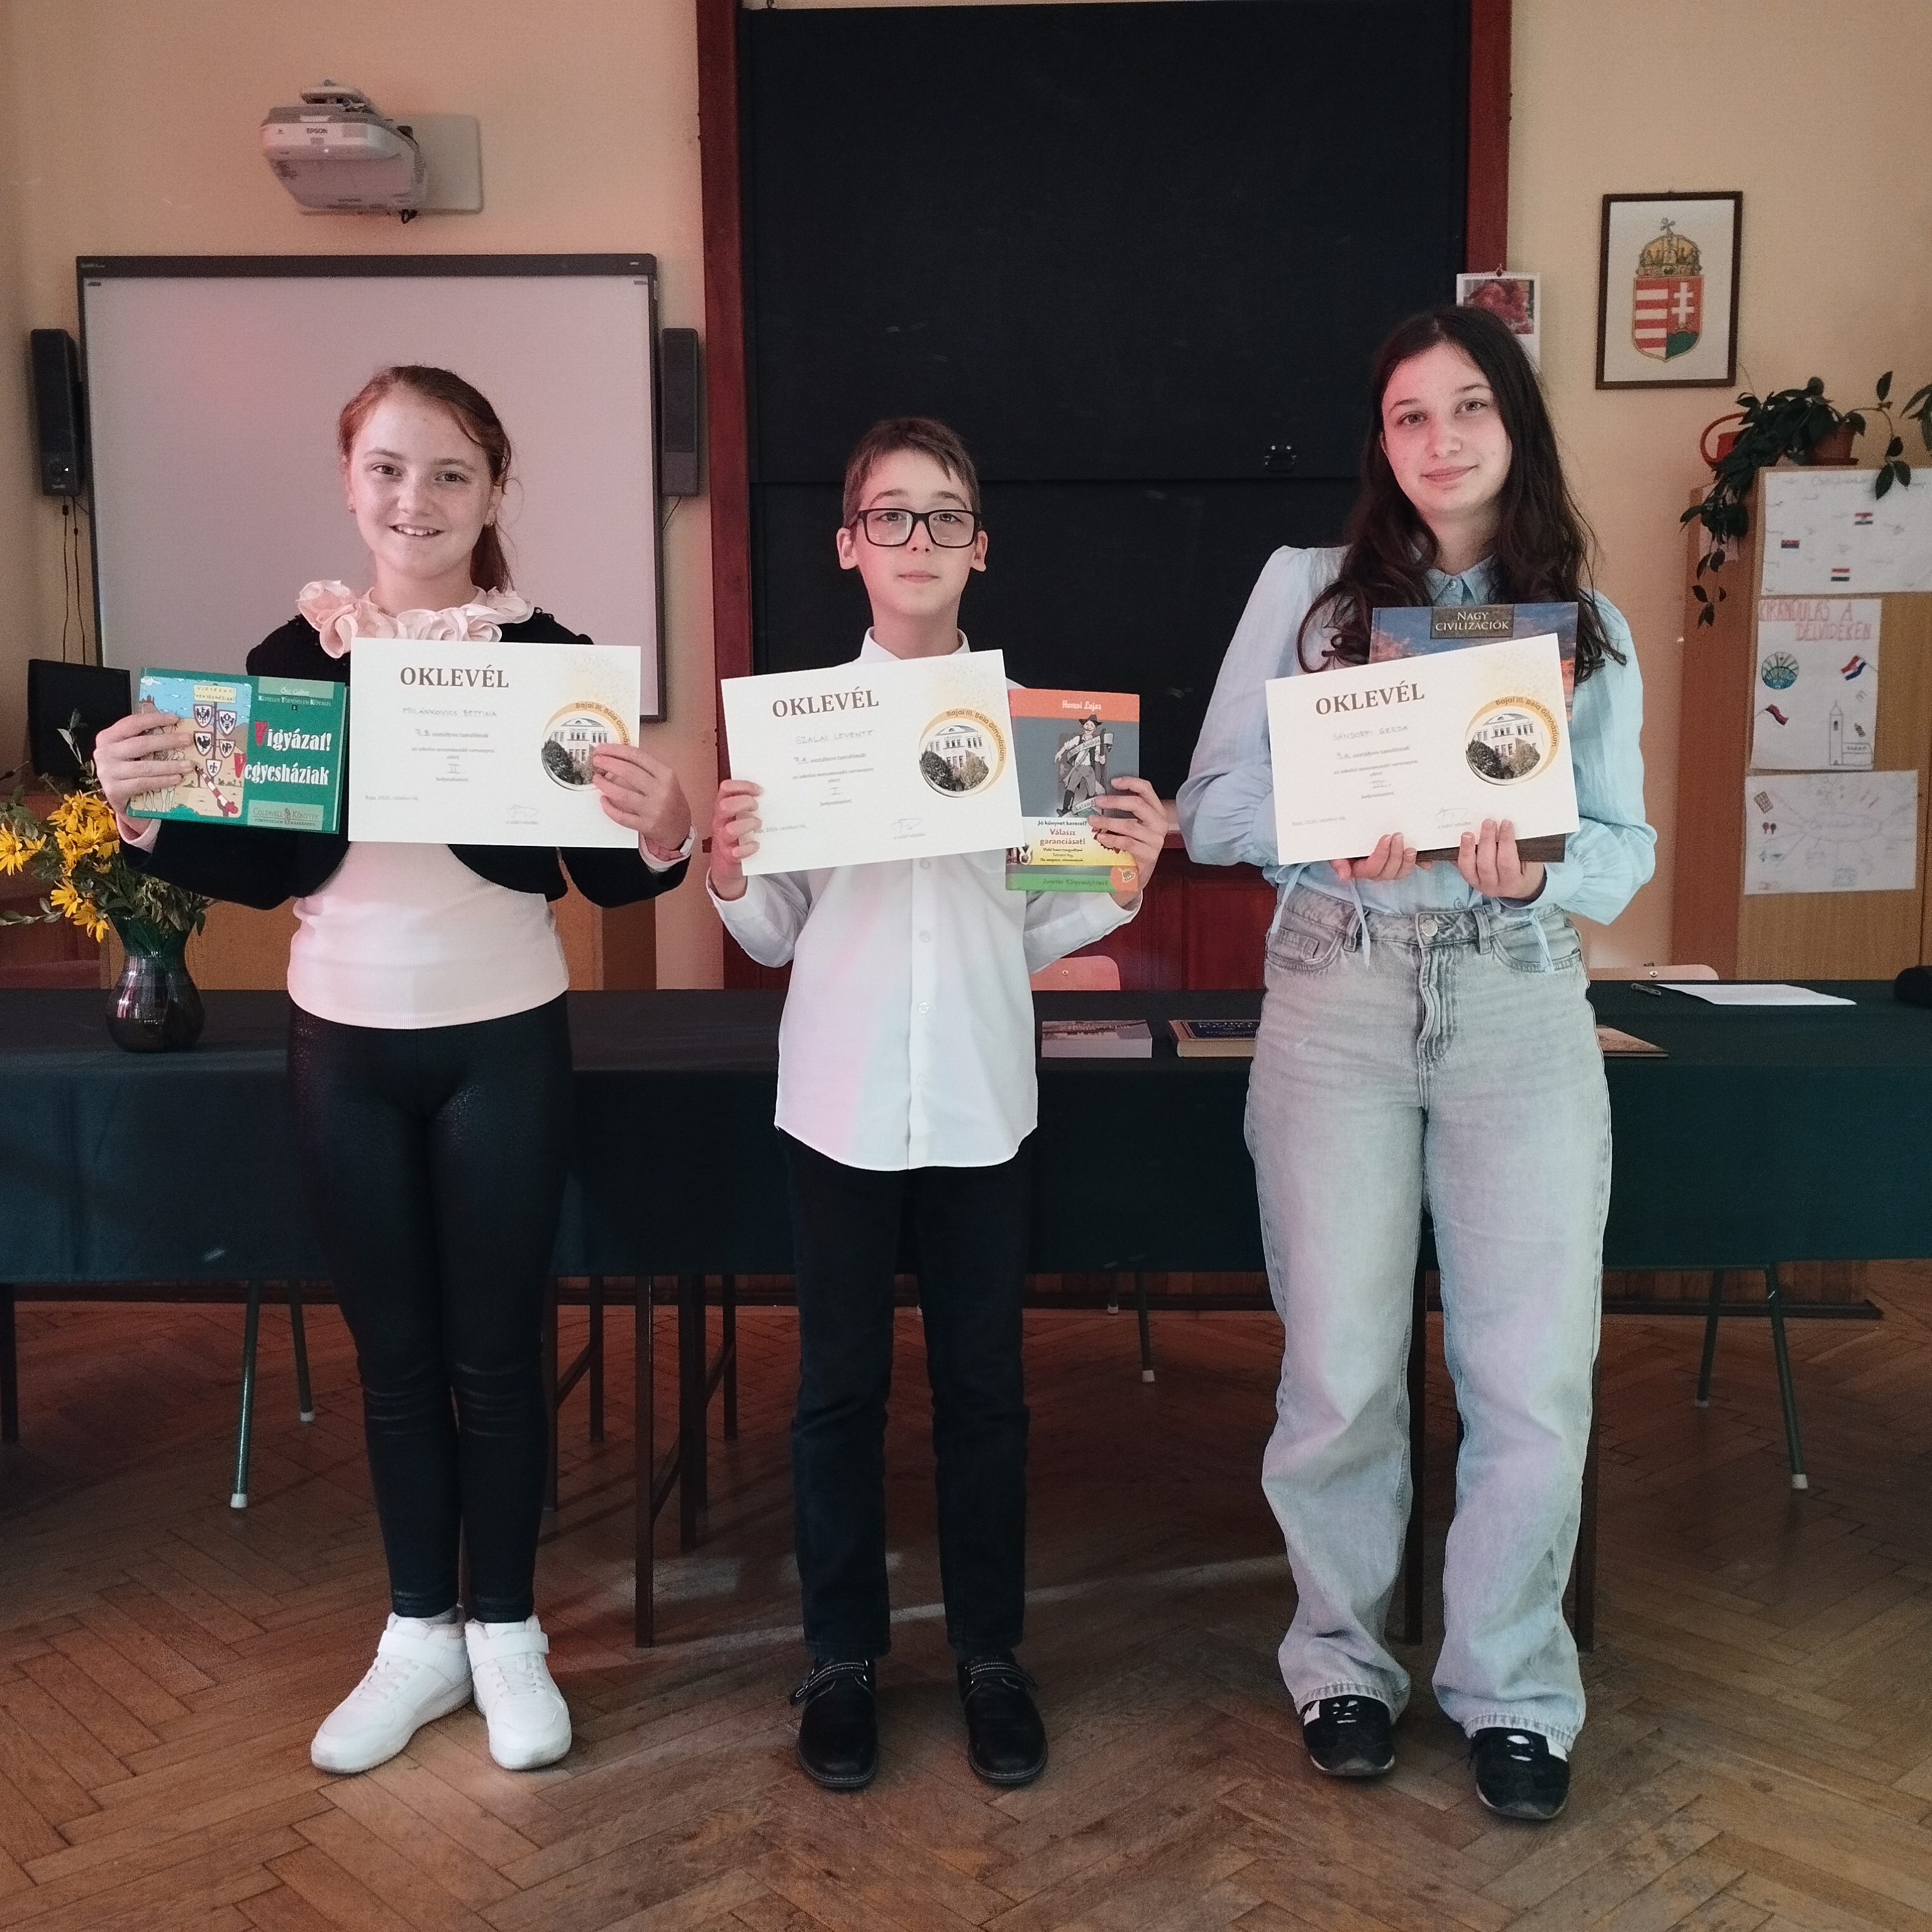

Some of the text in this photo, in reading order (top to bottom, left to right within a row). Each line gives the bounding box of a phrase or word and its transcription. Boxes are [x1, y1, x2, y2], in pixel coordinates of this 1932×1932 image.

[1457, 612, 1489, 621] NAGY
[1840, 601, 1853, 621] A
[1435, 619, 1509, 631] CIVILIZÁCIÓK
[401, 664, 509, 687] OKLEVÉL
[772, 686, 879, 718] OKLEVÉL
[1316, 680, 1425, 715] OKLEVÉL
[255, 721, 332, 751] Vigyázat!
[796, 730, 874, 744] SZALAI LEVENTE
[1379, 725, 1409, 735] GERDA
[1541, 708, 1559, 747] Gimnázium
[989, 723, 1005, 761] Gimnázium
[233, 753, 330, 785] Vegyesháziak
[1040, 838, 1085, 847] garanciásat!
